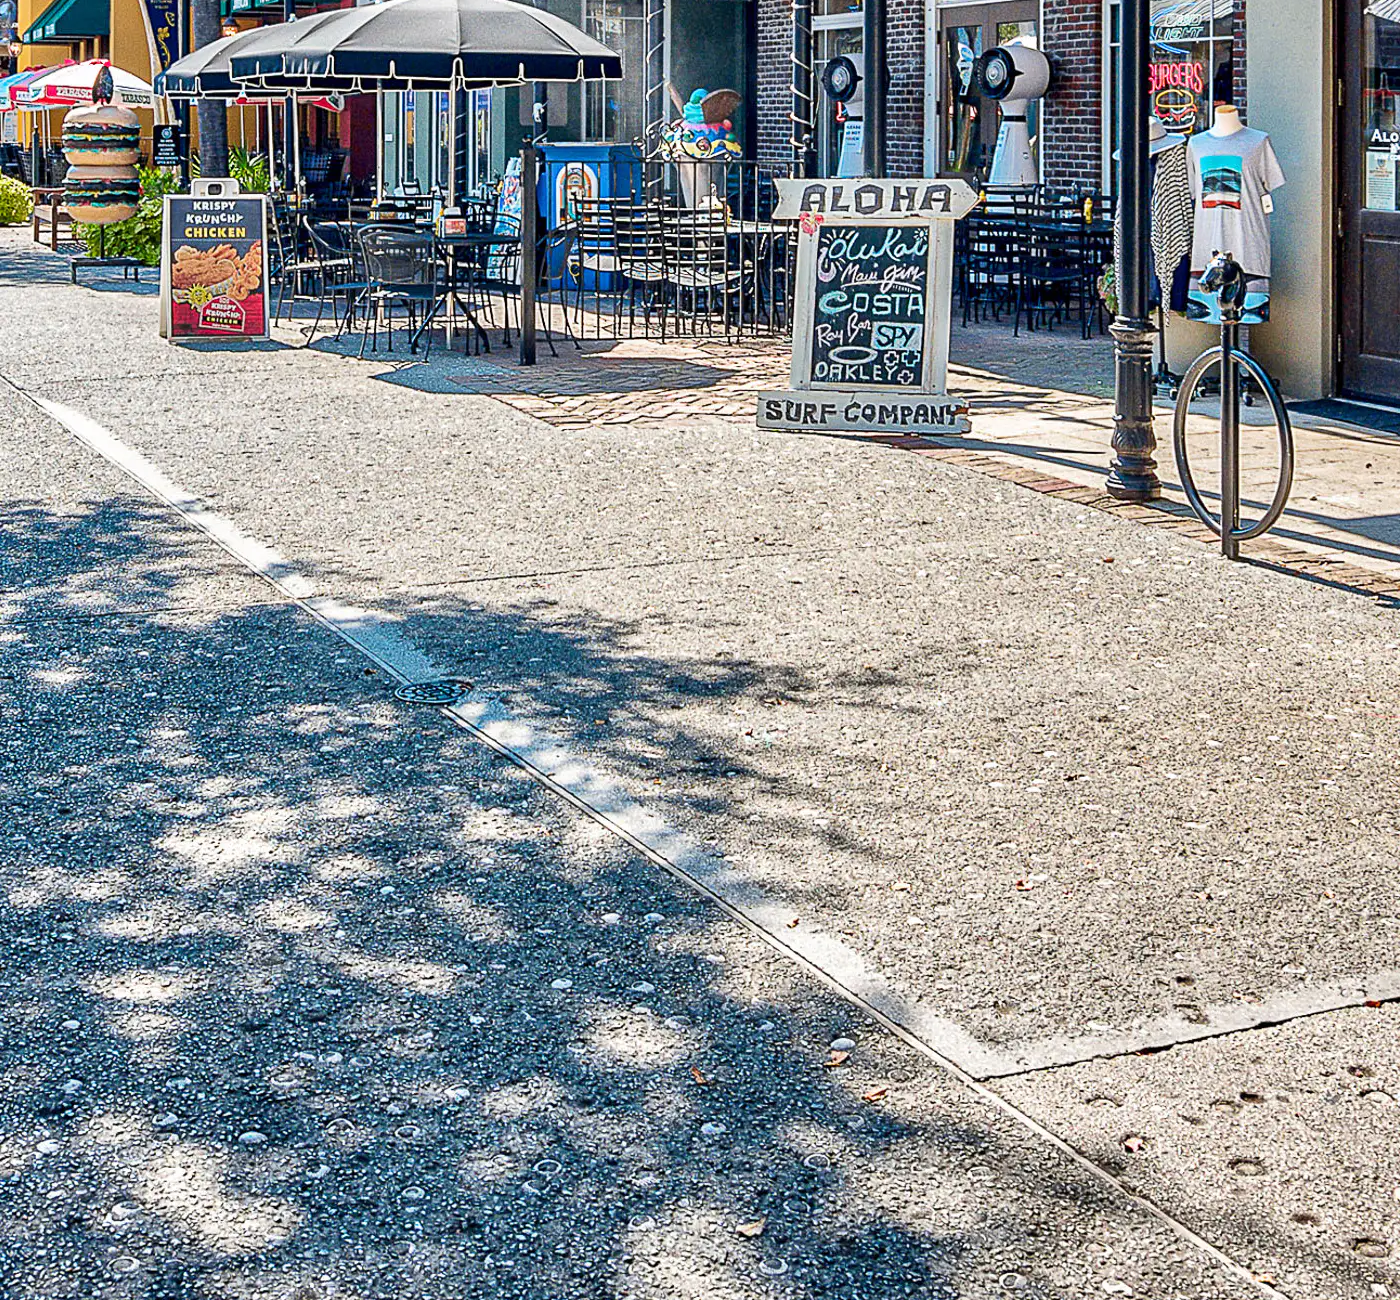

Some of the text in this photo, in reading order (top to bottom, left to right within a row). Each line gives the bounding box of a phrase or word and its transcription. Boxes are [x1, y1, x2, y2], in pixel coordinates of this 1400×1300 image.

[1155, 26, 1204, 40] LIGHT
[56, 86, 93, 100] TABASC
[193, 201, 236, 211] KRISPY
[800, 184, 951, 215] ALOHA
[185, 213, 243, 225] KRUNCHY
[184, 227, 246, 238] CHICKEN
[841, 262, 878, 283] Maui
[818, 290, 924, 317] COSTA
[815, 312, 872, 348] Ray Ban
[876, 326, 916, 347] SPY
[815, 360, 899, 382] OAKLEY
[766, 400, 960, 427] SURF COMPANY
